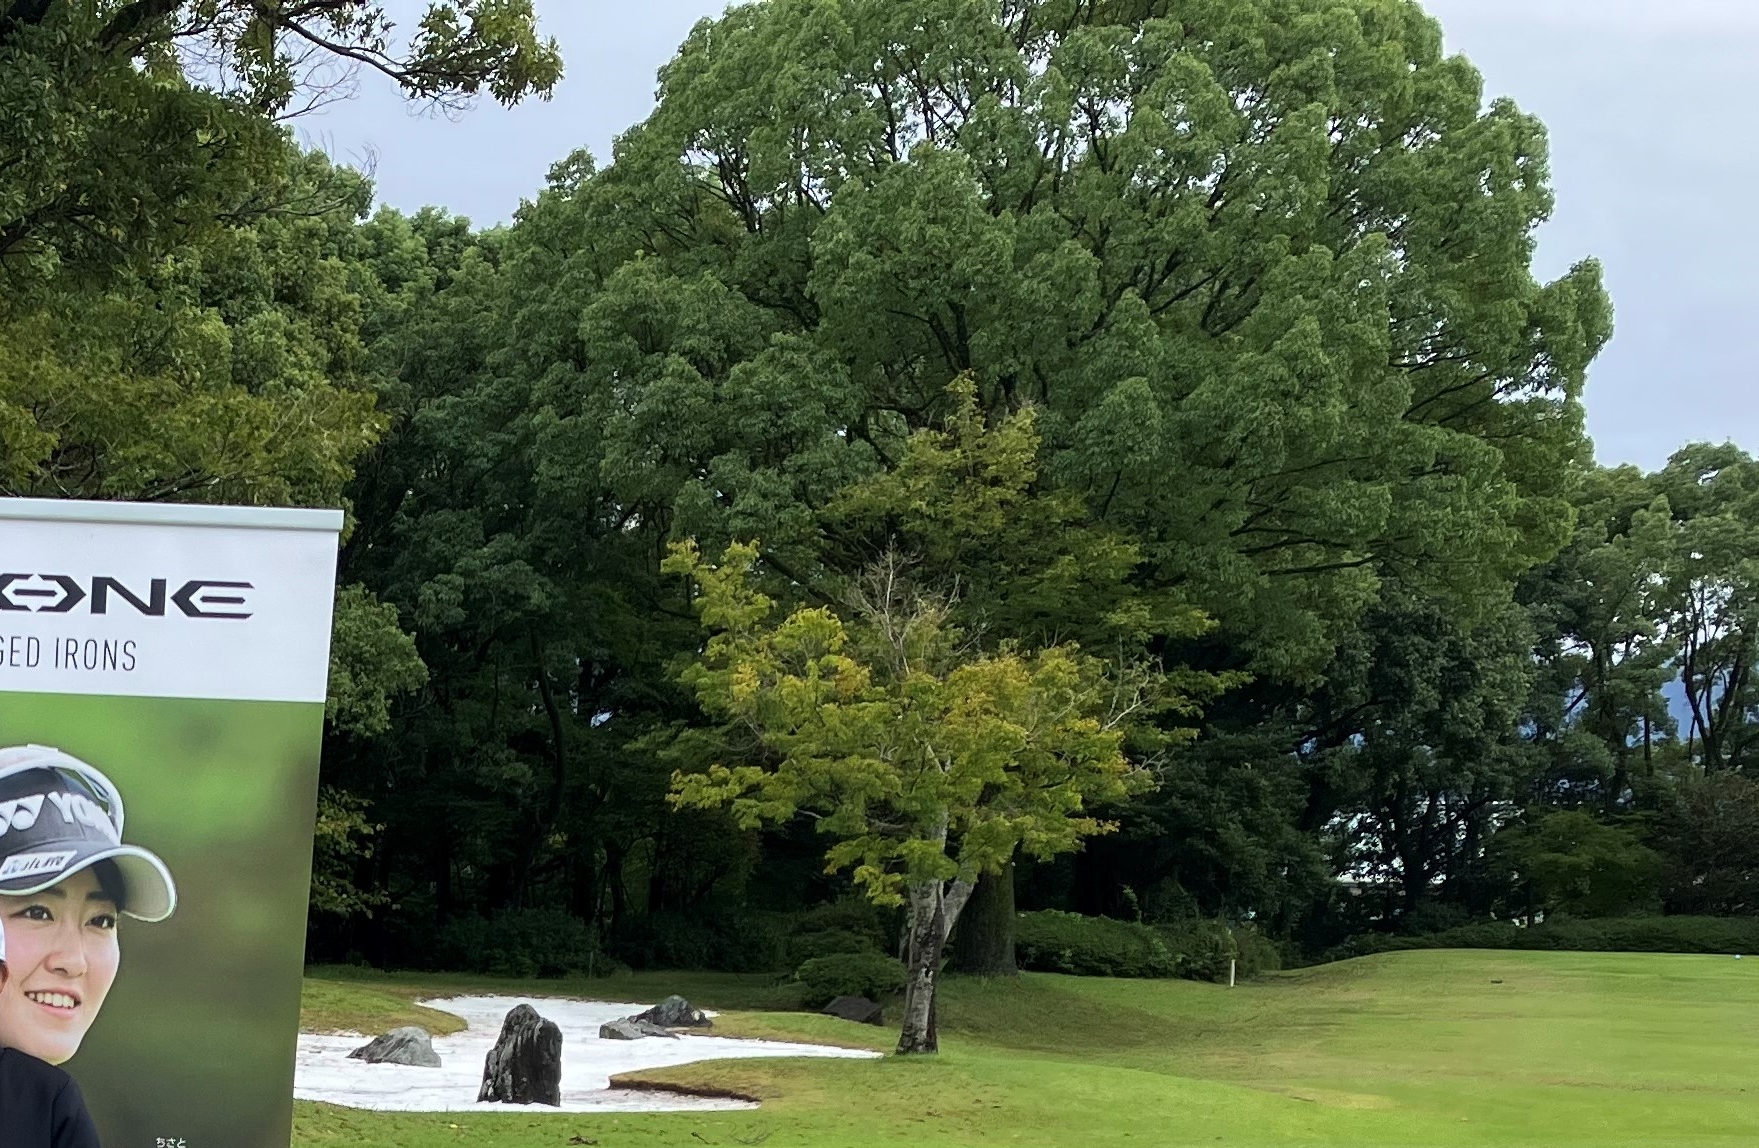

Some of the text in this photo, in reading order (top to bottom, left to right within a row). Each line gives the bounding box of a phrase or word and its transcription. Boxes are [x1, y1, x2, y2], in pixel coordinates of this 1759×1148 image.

[54, 638, 137, 671] IRONS
[155, 1137, 187, 1148] ちさと
